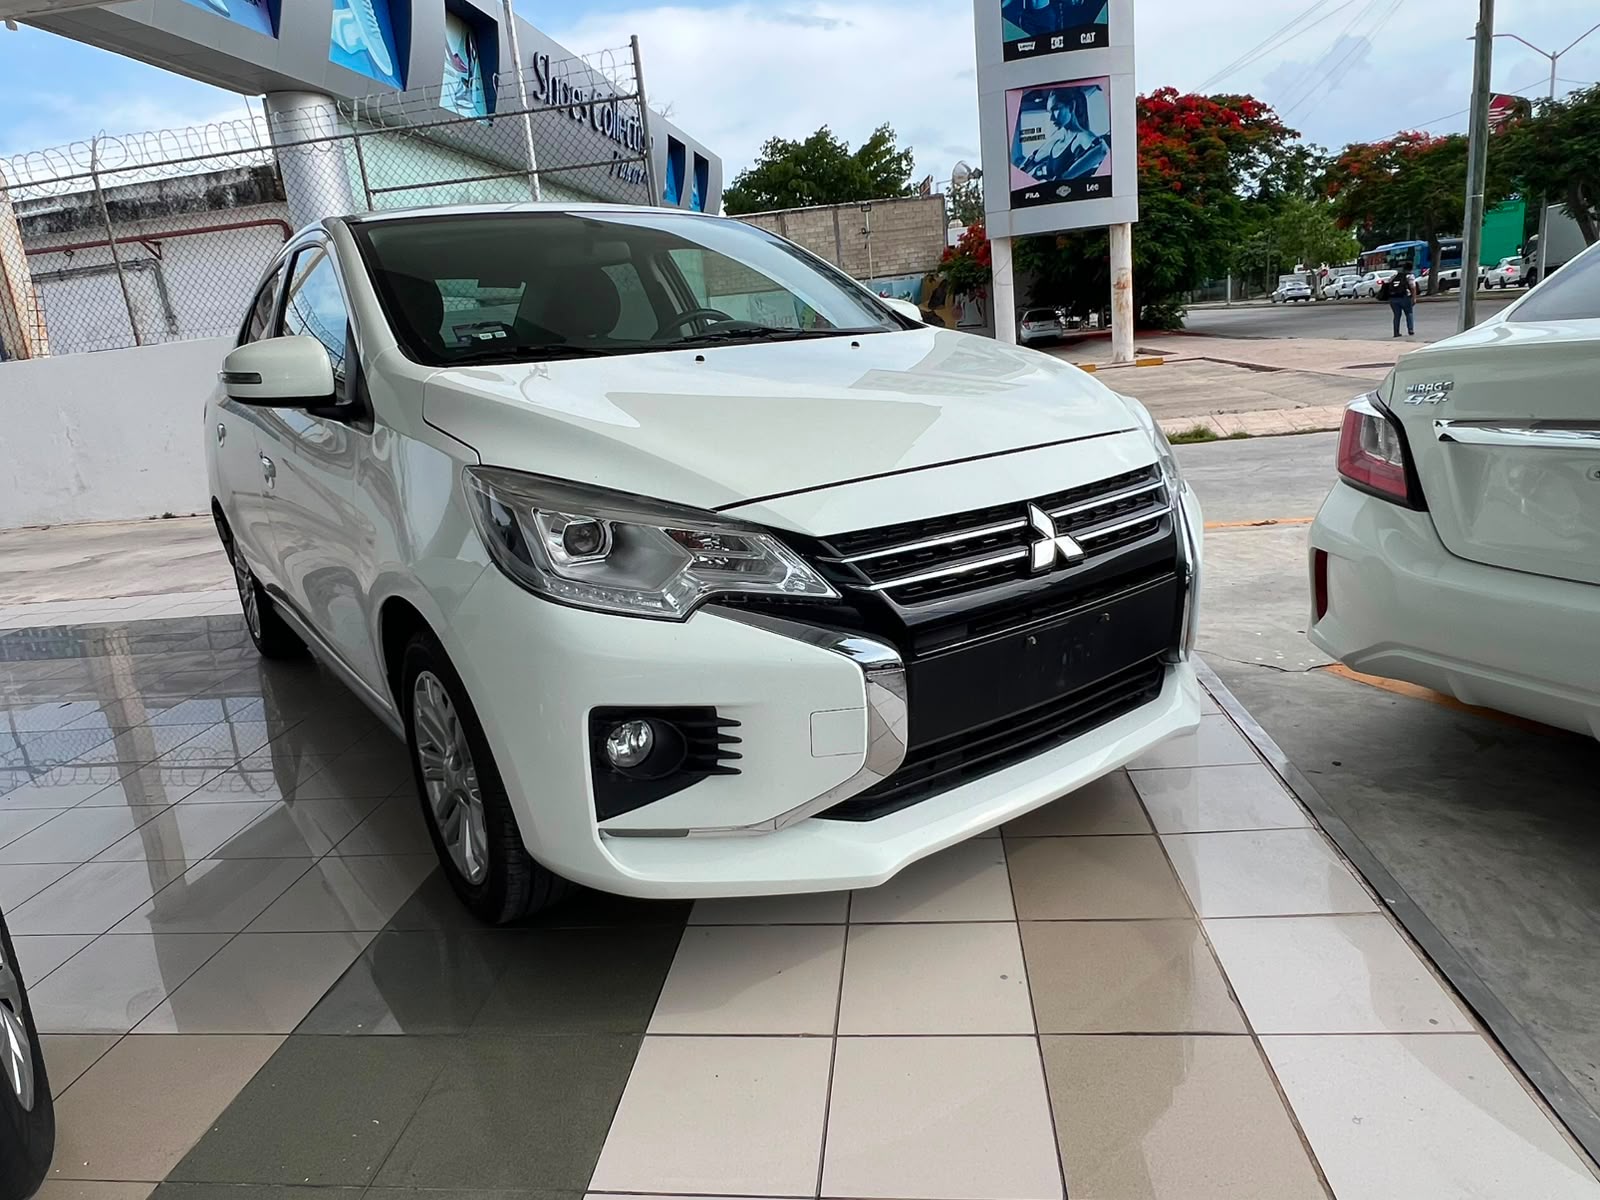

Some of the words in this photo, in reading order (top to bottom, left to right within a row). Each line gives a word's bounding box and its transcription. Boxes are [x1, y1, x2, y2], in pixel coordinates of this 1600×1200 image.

[1050, 36, 1064, 49] DC
[1080, 32, 1096, 44] CAT
[533, 51, 588, 124] Shoes
[1406, 381, 1454, 393] MIRAGE
[1404, 392, 1448, 405] G4
